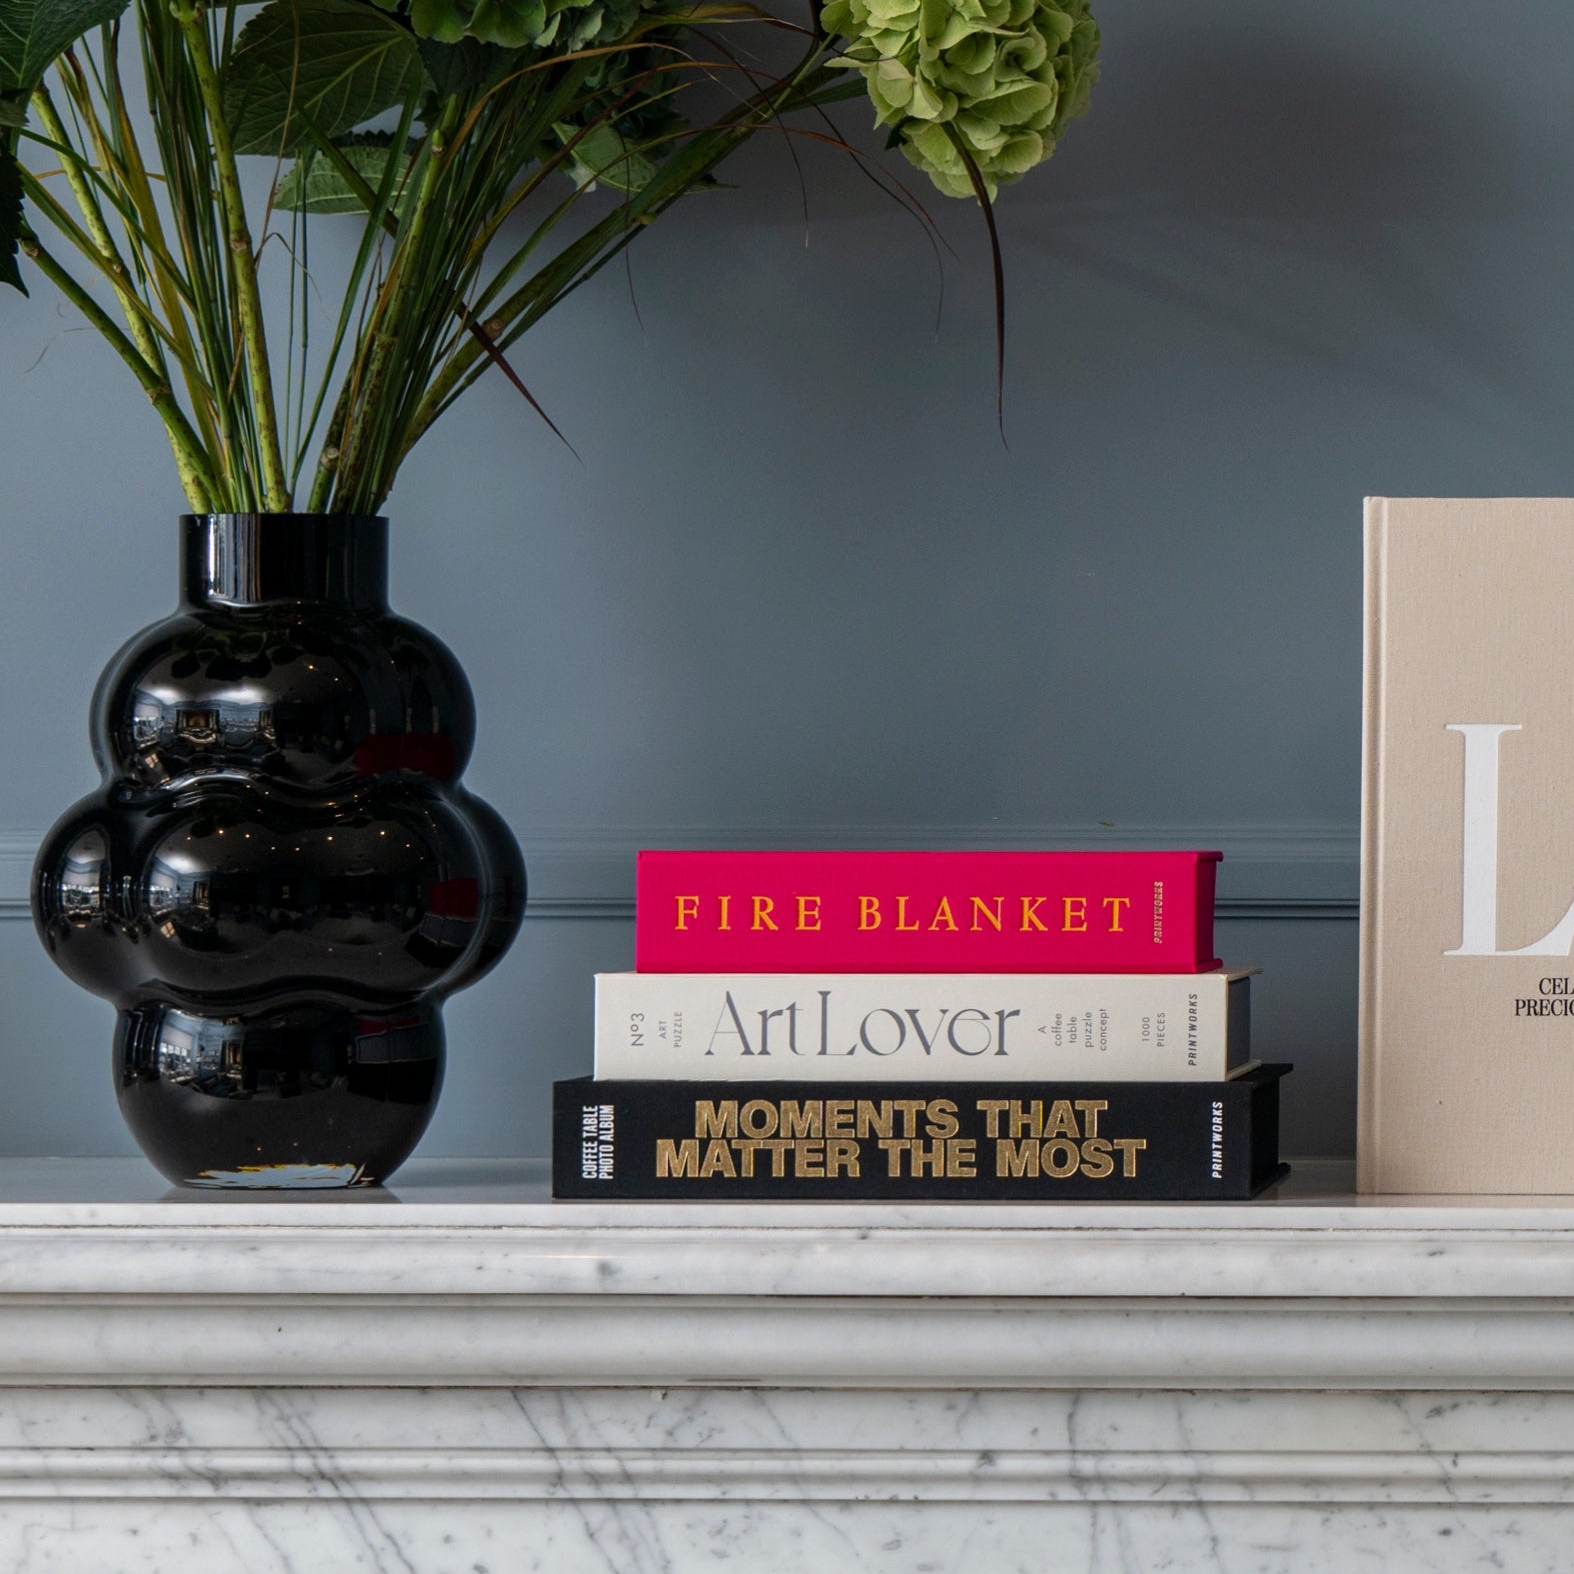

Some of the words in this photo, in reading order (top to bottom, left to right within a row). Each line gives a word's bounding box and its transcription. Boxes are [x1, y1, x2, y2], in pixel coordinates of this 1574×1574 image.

[676, 896, 820, 930] FIRE
[859, 897, 1129, 931] BLANKET
[673, 1010, 683, 1048] PUZZLE
[1038, 1026, 1046, 1034] A
[1054, 1013, 1063, 1047] coffee
[1068, 1016, 1077, 1044] table
[1085, 1011, 1093, 1048] puzzle
[1099, 1008, 1108, 1051] concept
[1141, 1016, 1150, 1042] 1000
[1157, 1012, 1165, 1047] PIECES
[1188, 994, 1197, 1065] PRINTWORKS
[582, 1105, 598, 1135] TABLE
[599, 1104, 614, 1141] ALBUM
[695, 1100, 959, 1138] MOMENTS
[977, 1100, 1108, 1138] THAT
[582, 1137, 598, 1180] COFFEE
[656, 1139, 859, 1178] MATTER
[878, 1139, 976, 1178] THE
[996, 1139, 1146, 1178] MOST
[1212, 1102, 1222, 1178] PRINTWORKS
[599, 1144, 614, 1180] PHOTO
